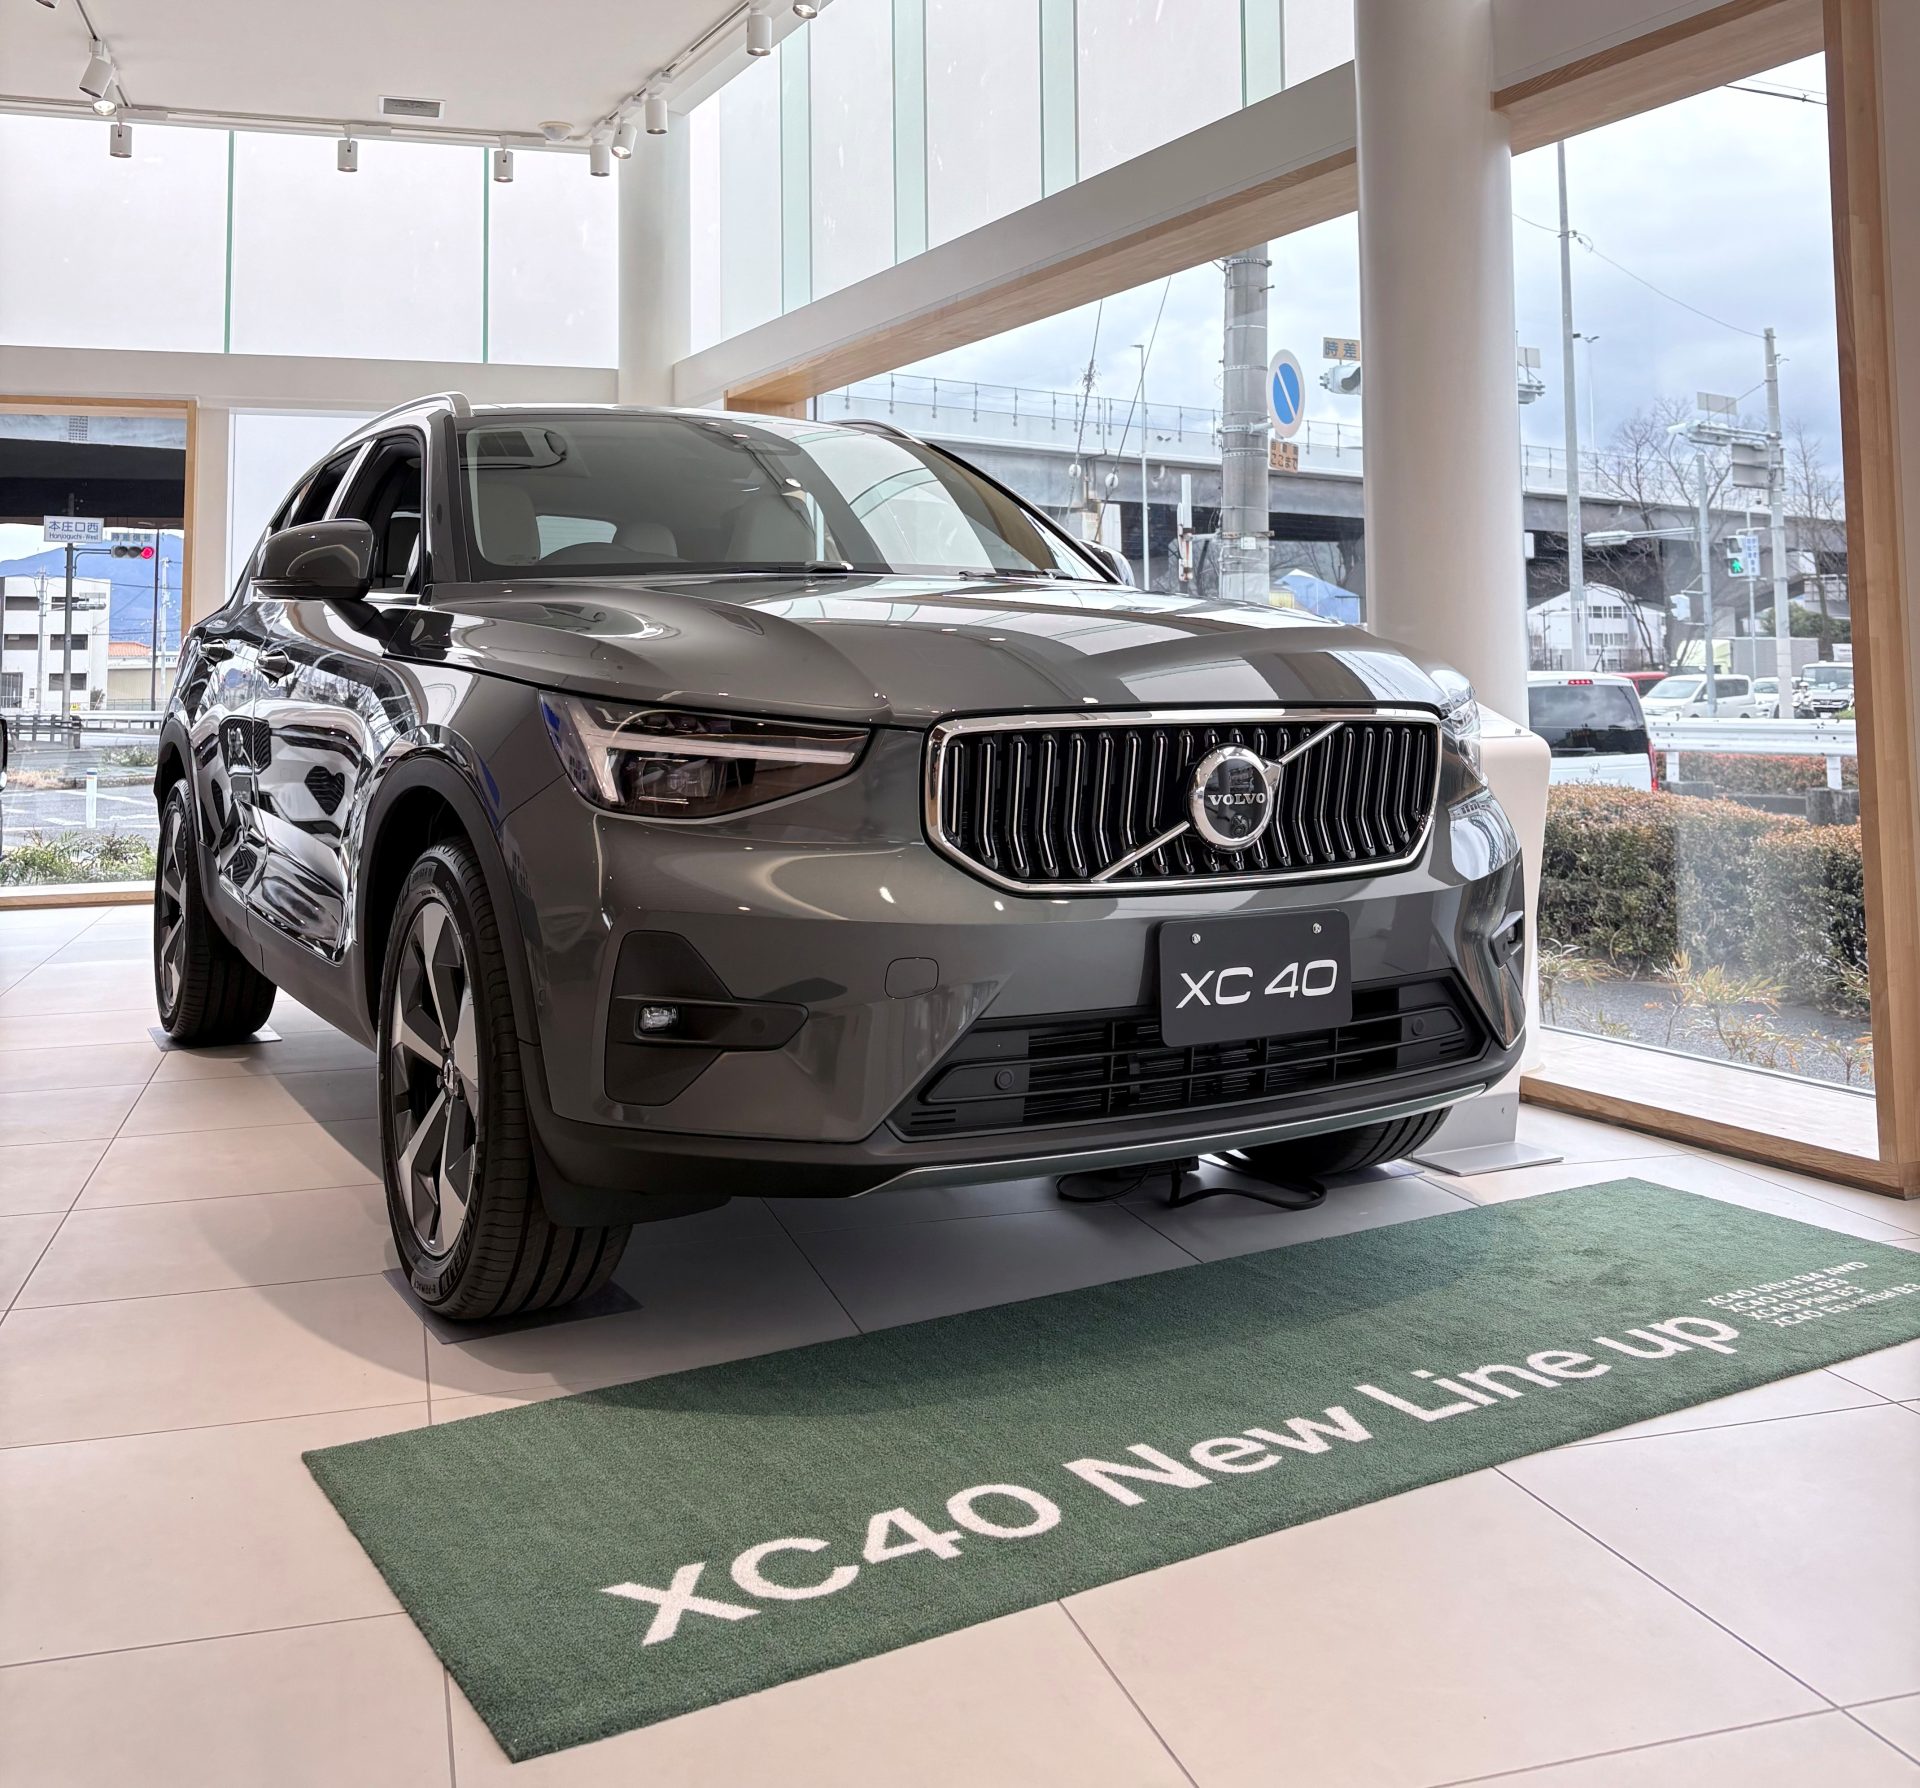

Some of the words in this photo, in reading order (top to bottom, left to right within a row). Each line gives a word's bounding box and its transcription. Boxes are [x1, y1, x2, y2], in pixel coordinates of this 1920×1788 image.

[1270, 453, 1298, 470] ここまで
[48, 520, 99, 533] 本庄口西
[1208, 792, 1267, 806] VOLVO
[1175, 966, 1254, 1009] XC
[1264, 959, 1338, 998] 40
[1701, 1290, 1757, 1306] XC40
[1751, 1280, 1804, 1292] Ultra
[1823, 1261, 1868, 1275] AWD
[1720, 1296, 1778, 1312] XC40
[1742, 1303, 1800, 1320] XC40
[1767, 1310, 1825, 1327] XC40
[600, 1484, 1062, 1647] XC40
[1062, 1405, 1374, 1506] New
[1354, 1350, 1612, 1422] Line
[1594, 1316, 1741, 1359] up
